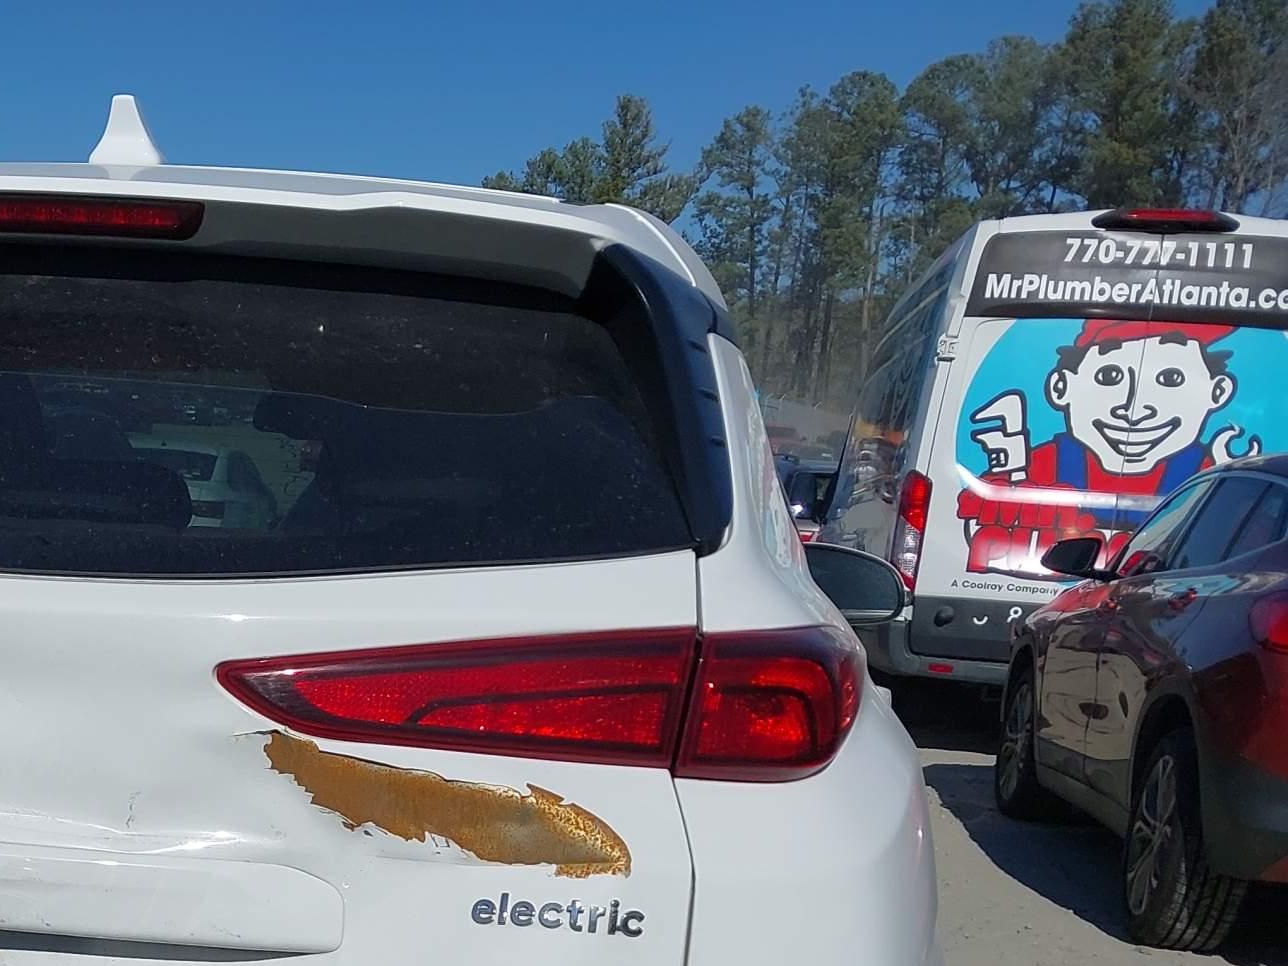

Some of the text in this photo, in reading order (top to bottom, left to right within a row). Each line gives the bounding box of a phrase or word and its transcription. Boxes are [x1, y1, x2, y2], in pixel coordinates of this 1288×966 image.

[1063, 237, 1254, 269] 770-777-1111
[950, 579, 959, 588] A
[961, 579, 1004, 593] Coolray
[471, 892, 645, 938] electric
